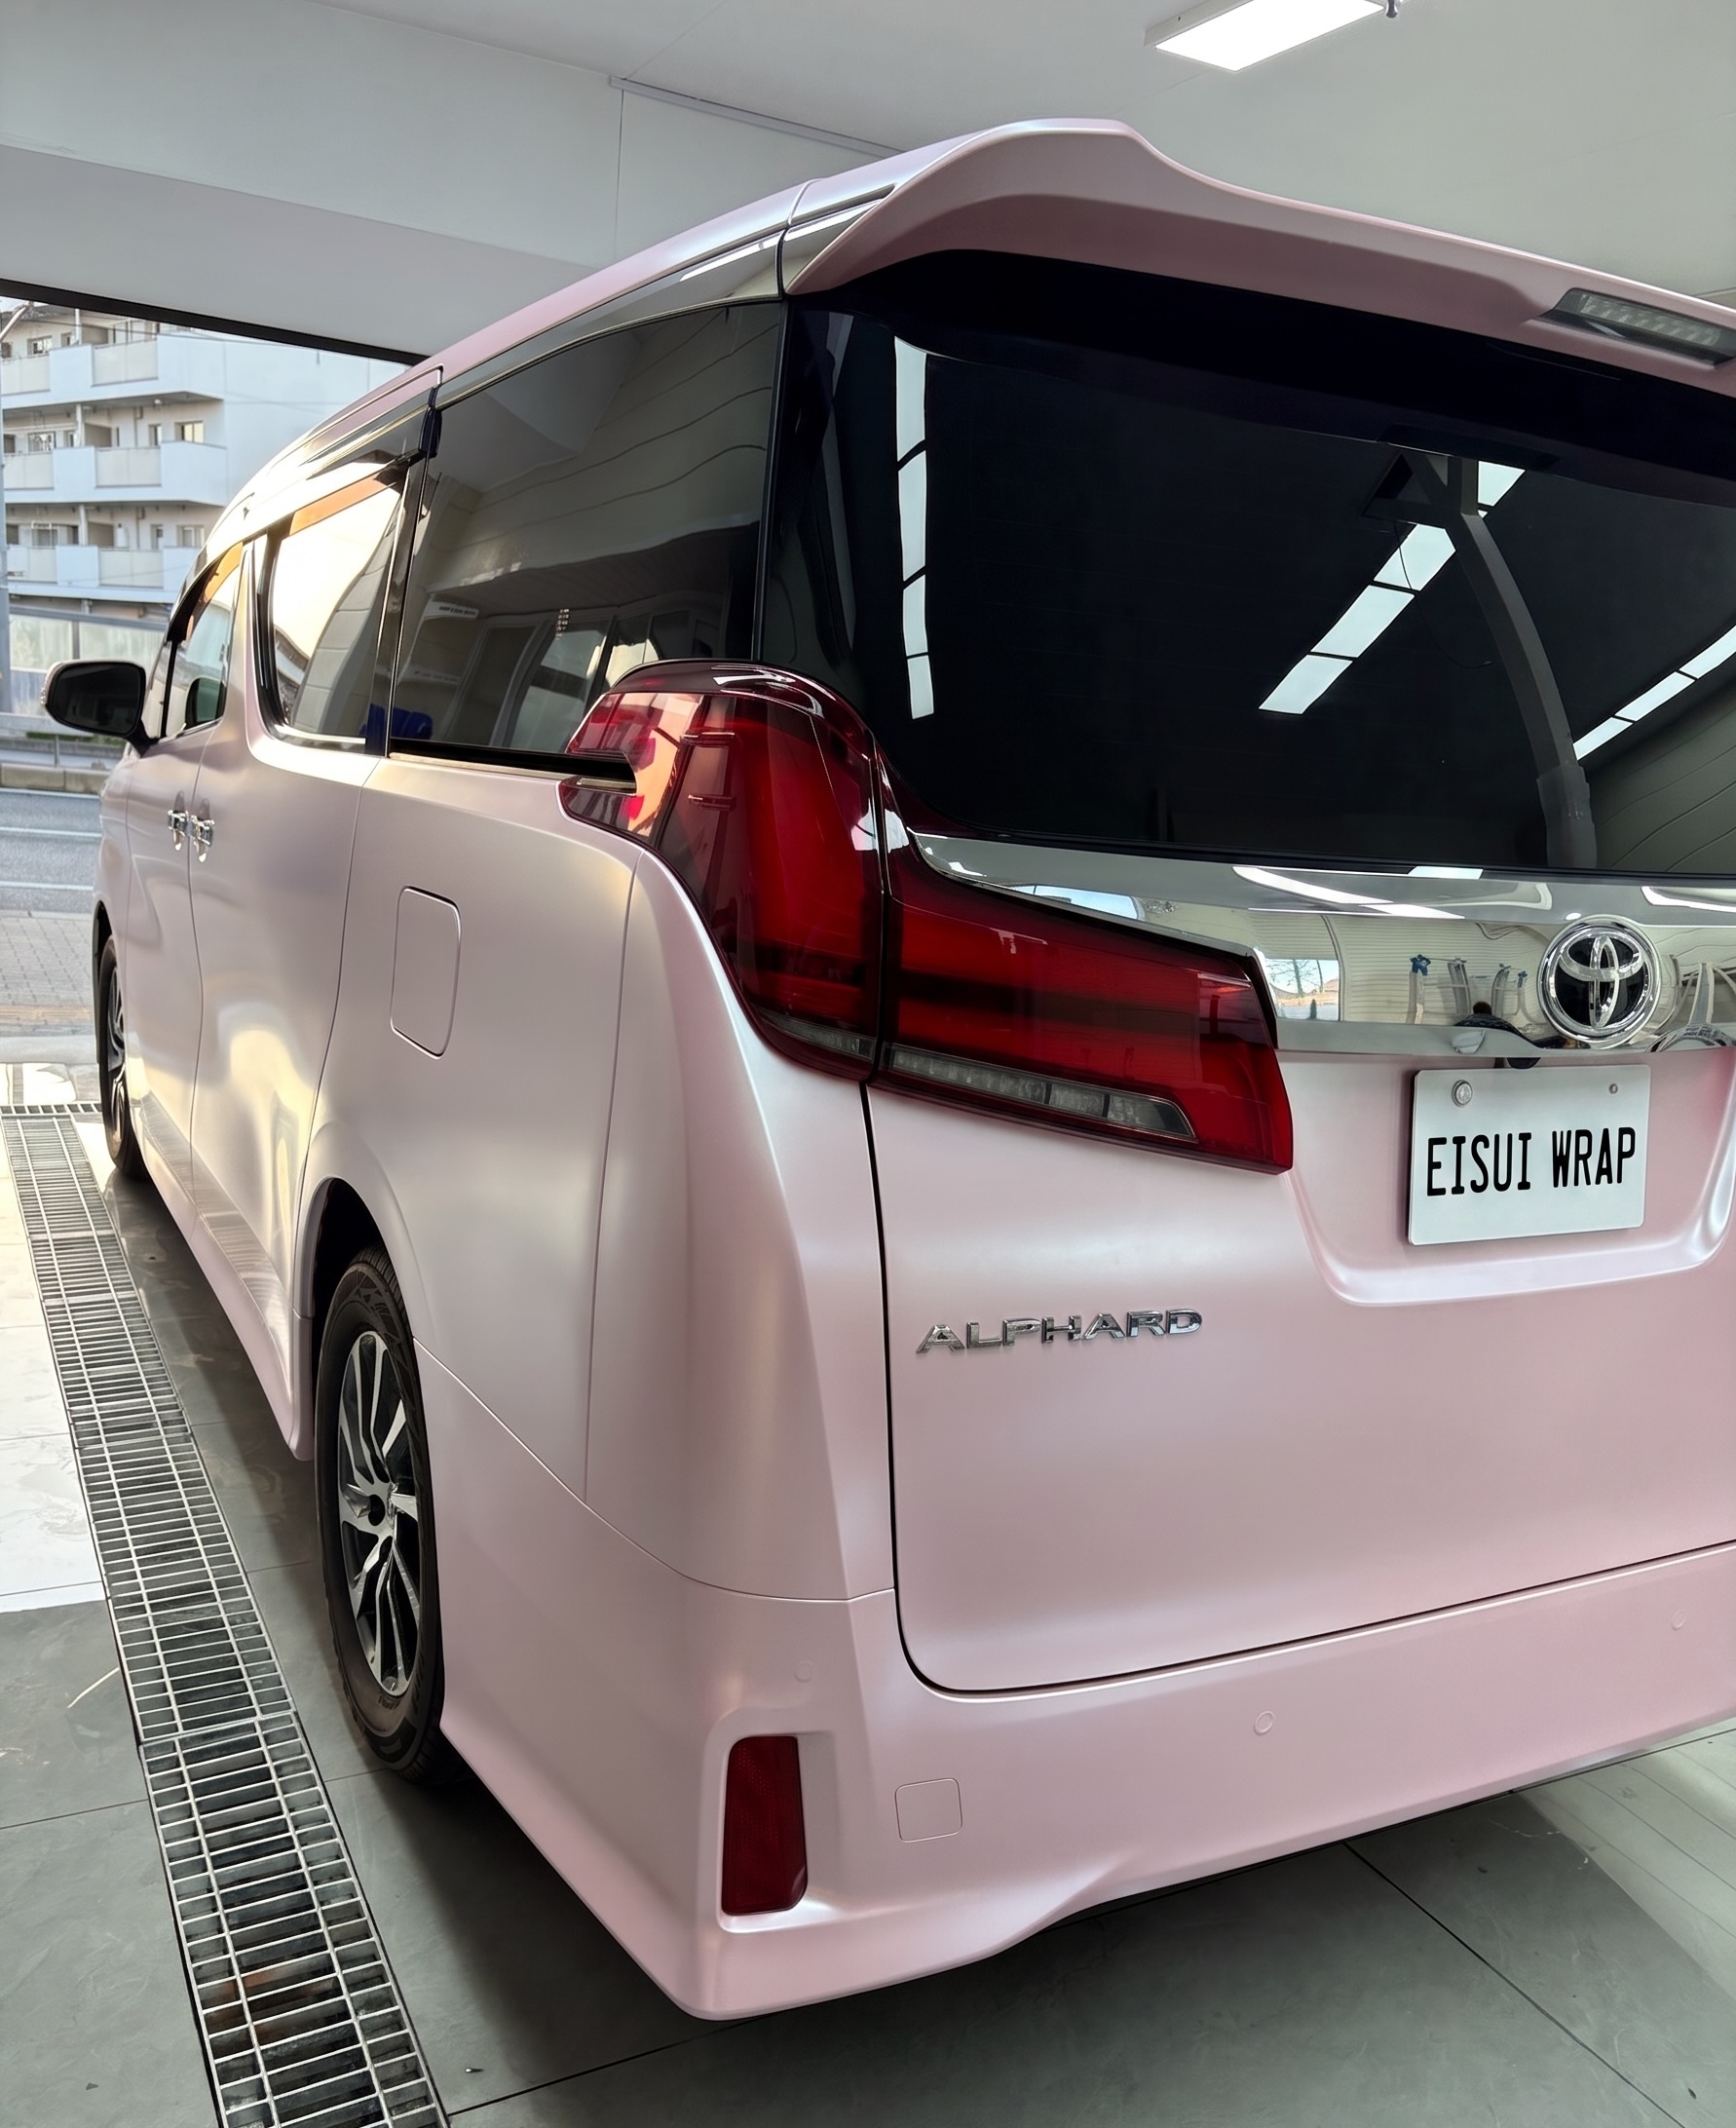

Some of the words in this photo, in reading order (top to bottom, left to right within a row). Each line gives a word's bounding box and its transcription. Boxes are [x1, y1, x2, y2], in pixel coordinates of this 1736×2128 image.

[1426, 1132, 1532, 1197] EISUI
[1552, 1126, 1636, 1188] WRAP
[916, 1308, 1202, 1353] ALPHARD
